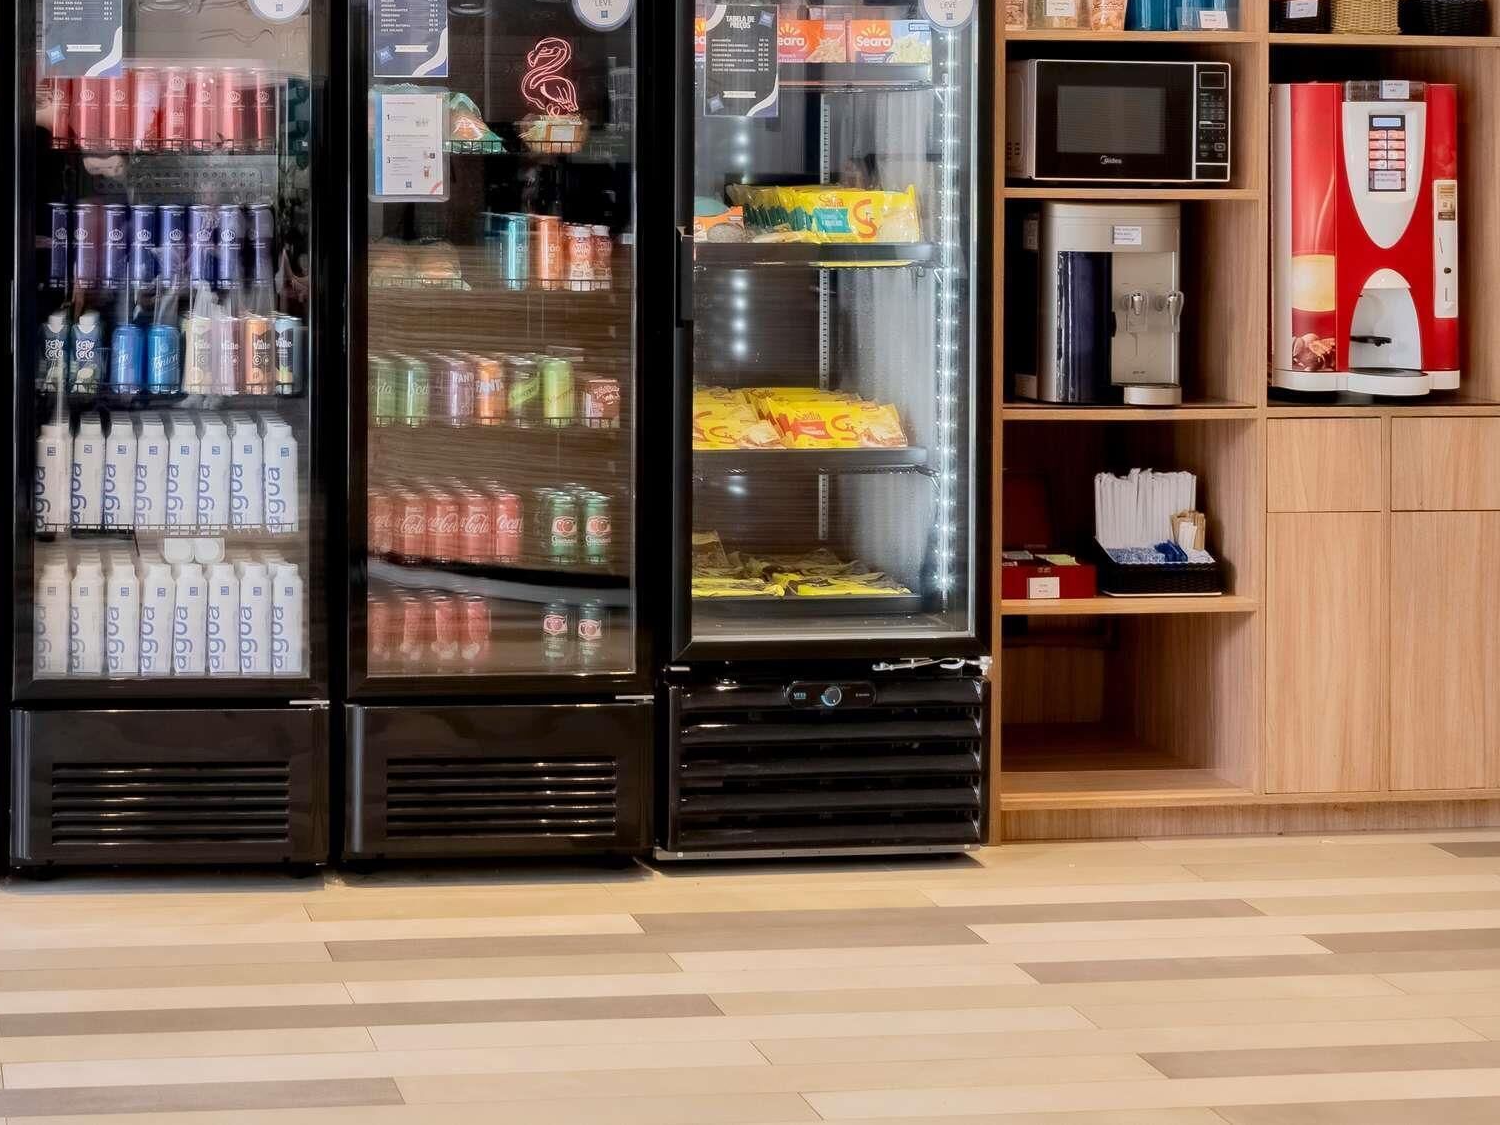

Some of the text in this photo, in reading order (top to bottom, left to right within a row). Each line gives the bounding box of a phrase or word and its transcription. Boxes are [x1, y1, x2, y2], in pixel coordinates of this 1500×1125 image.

[747, 15, 755, 23] DE
[778, 36, 805, 47] eara
[856, 35, 892, 47] Seara
[108, 606, 124, 669] agua
[141, 606, 158, 669] agua
[175, 606, 193, 669] agua
[209, 606, 226, 669] agua
[241, 606, 258, 669] agua
